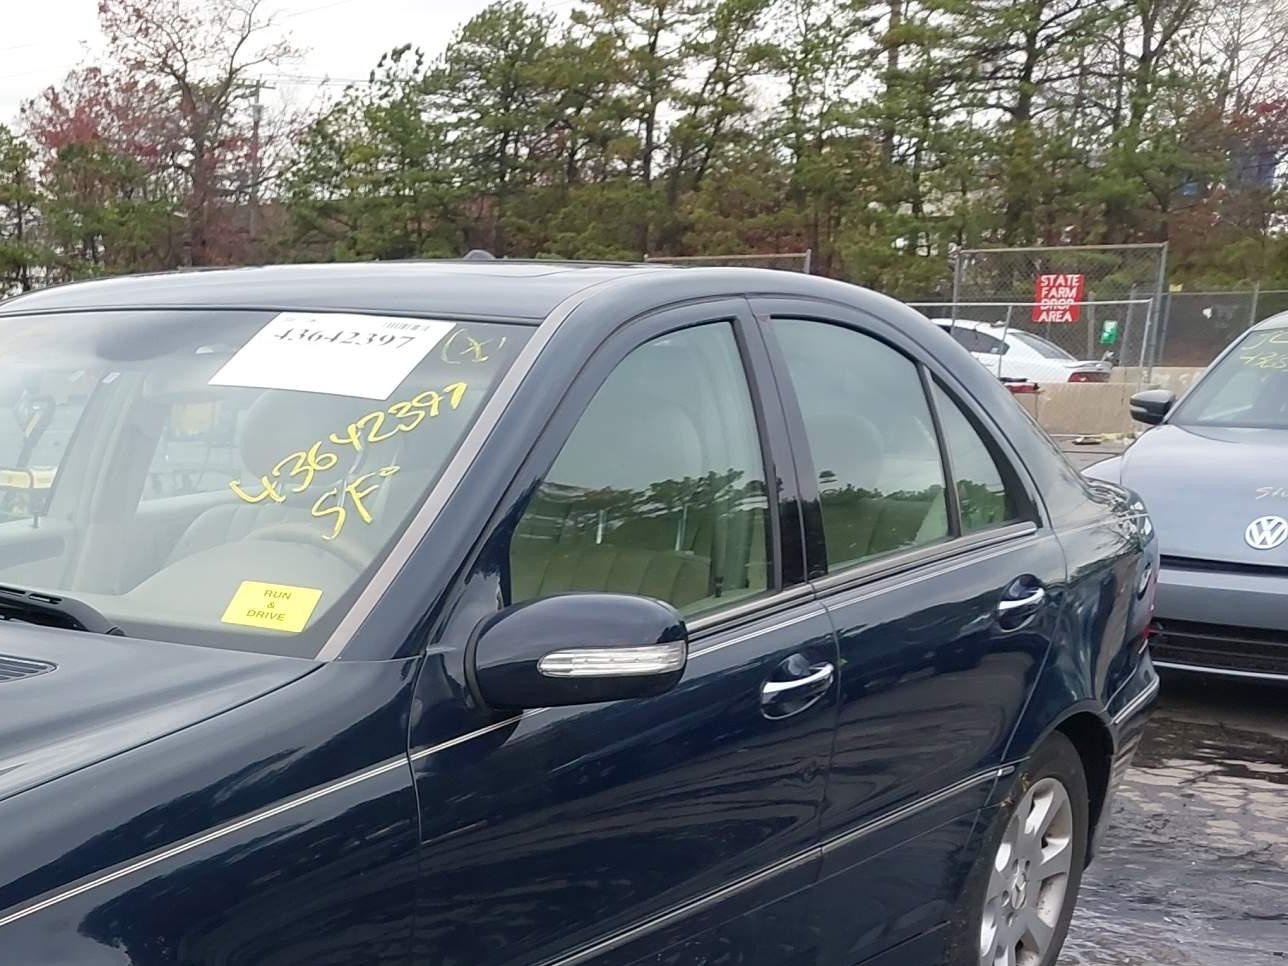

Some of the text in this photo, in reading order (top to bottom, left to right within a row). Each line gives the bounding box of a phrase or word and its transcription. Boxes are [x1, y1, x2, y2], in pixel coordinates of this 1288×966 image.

[1040, 274, 1080, 287] STATE
[1041, 286, 1078, 299] FARM
[1040, 298, 1074, 310] DROP
[1038, 310, 1073, 322] AREA
[274, 326, 416, 349] 43642397
[228, 382, 468, 504] 43642397
[263, 589, 292, 600] RUN
[267, 601, 275, 609] &
[246, 609, 286, 622] DRIVE
